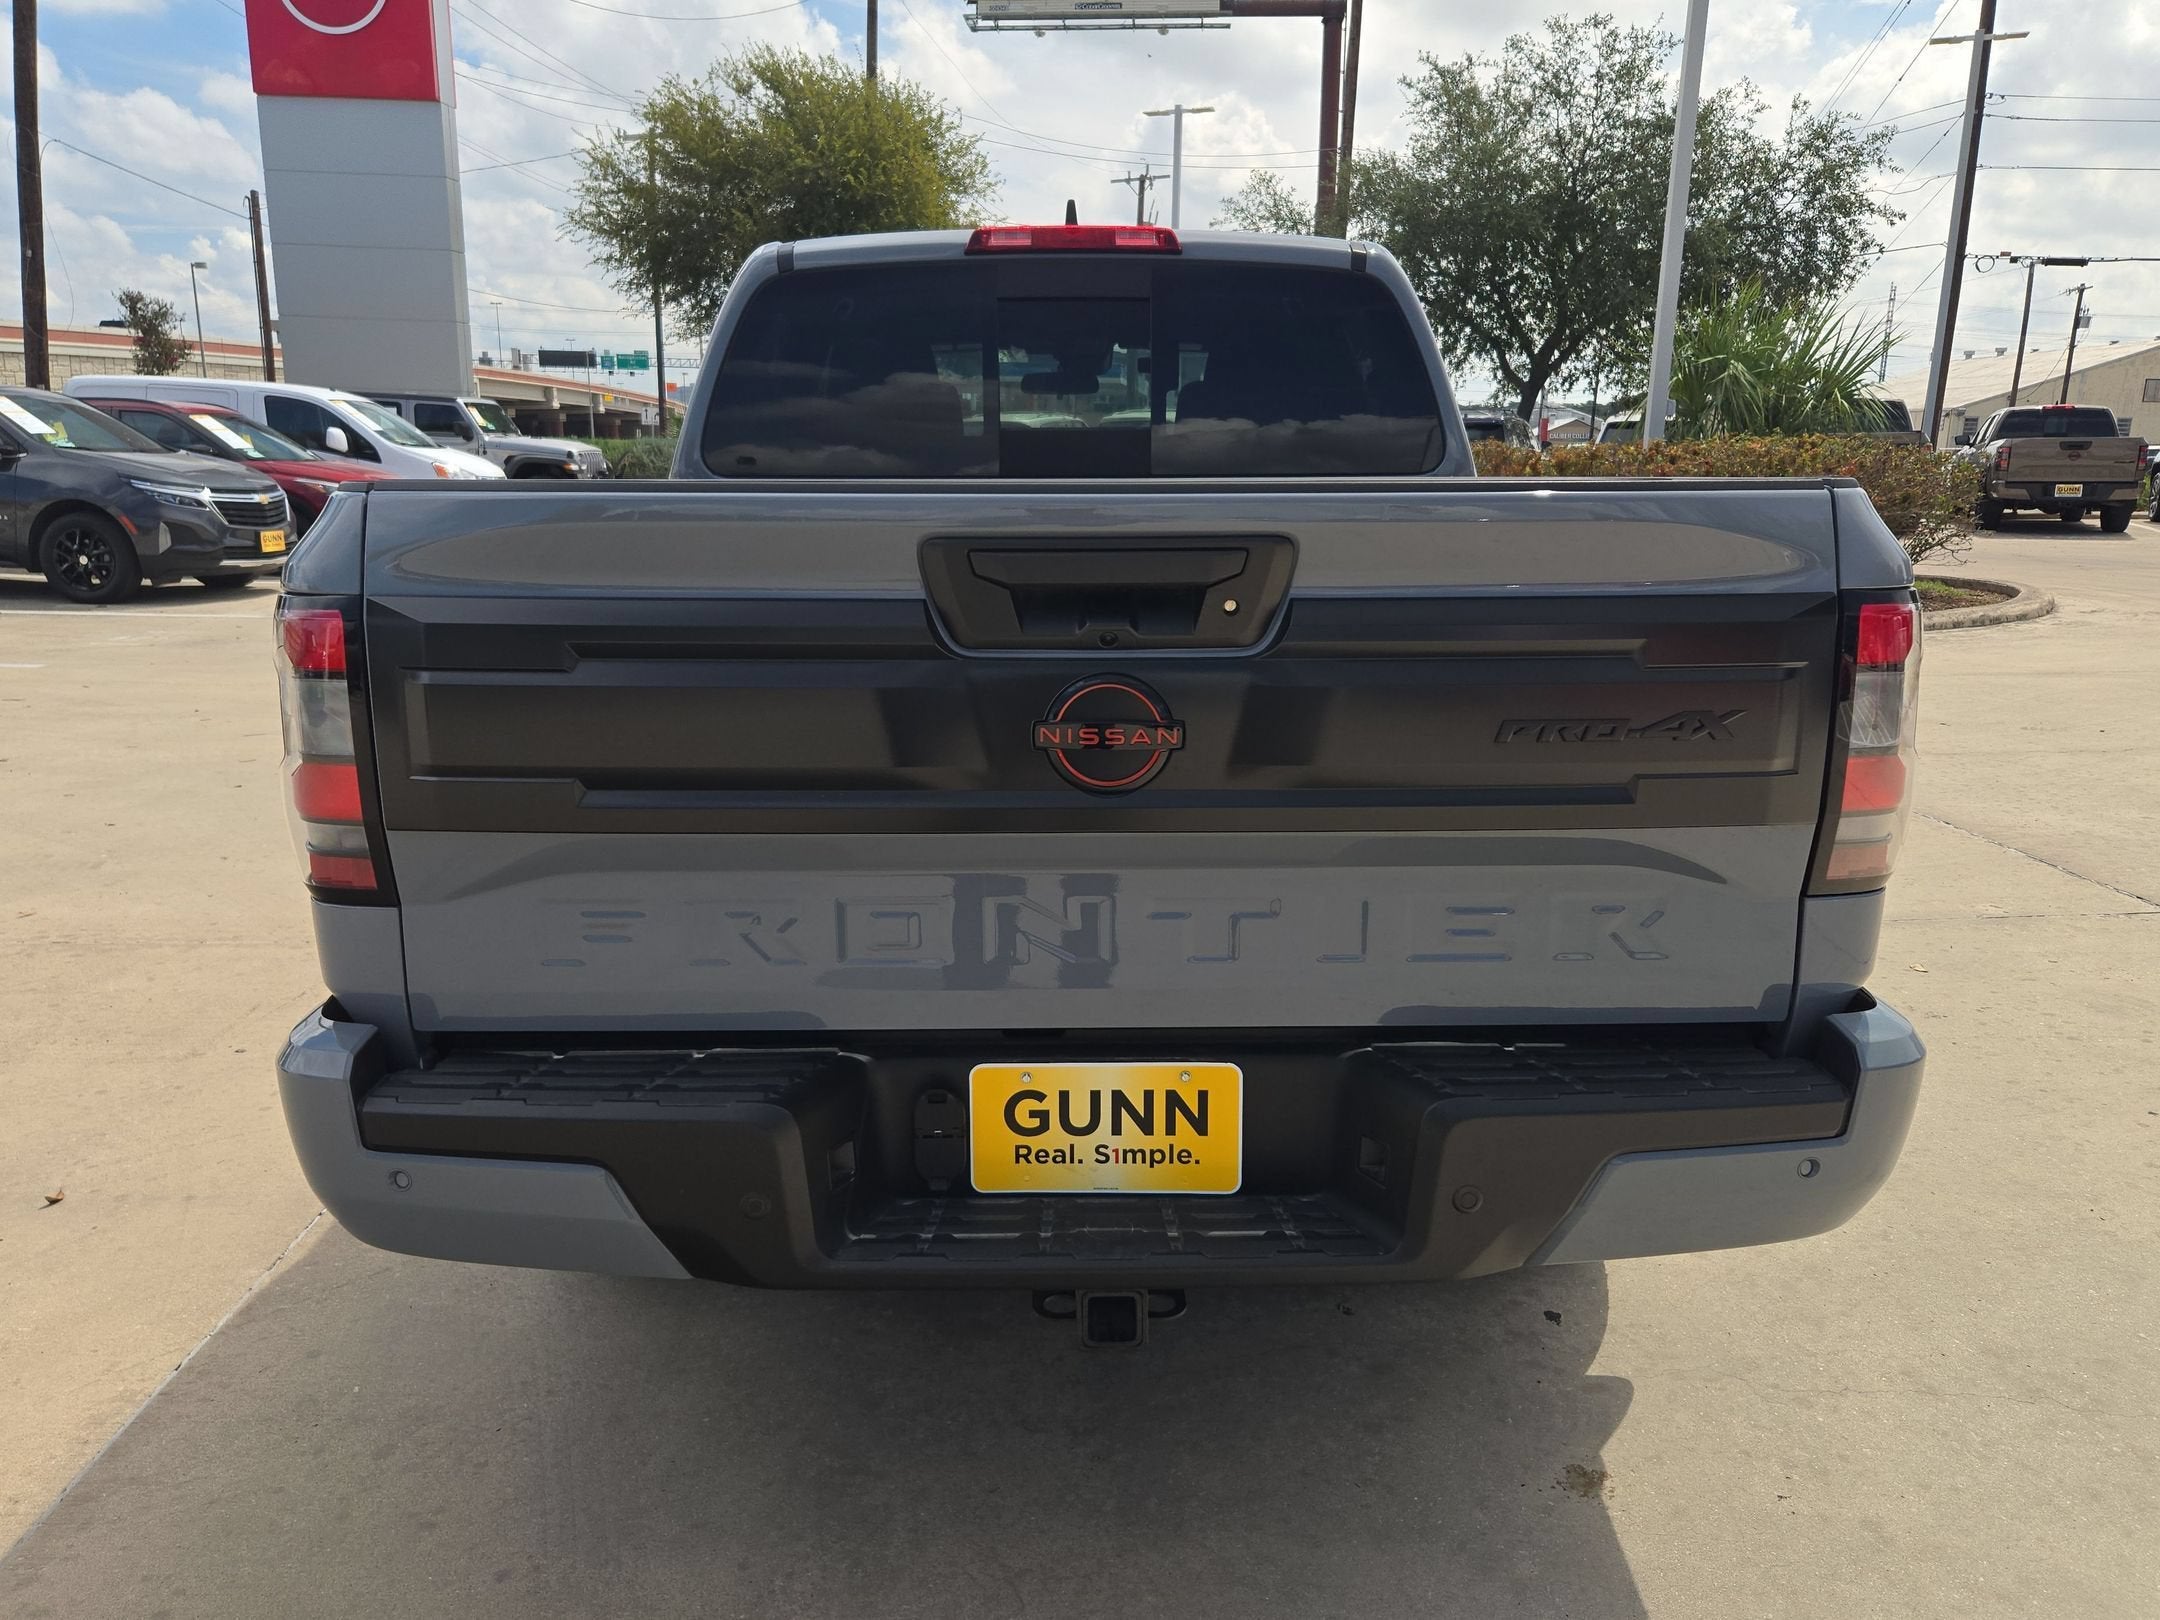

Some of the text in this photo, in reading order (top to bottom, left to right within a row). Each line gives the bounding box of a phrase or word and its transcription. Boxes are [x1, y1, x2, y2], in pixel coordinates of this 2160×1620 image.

[263, 534, 283, 543] GUNN
[1039, 727, 1180, 745] NISSAN
[1494, 710, 1748, 743] PRO-4X
[540, 894, 1671, 968] FRONTIER
[1003, 1089, 1209, 1137] GUNN
[1014, 1144, 1083, 1165] Real.
